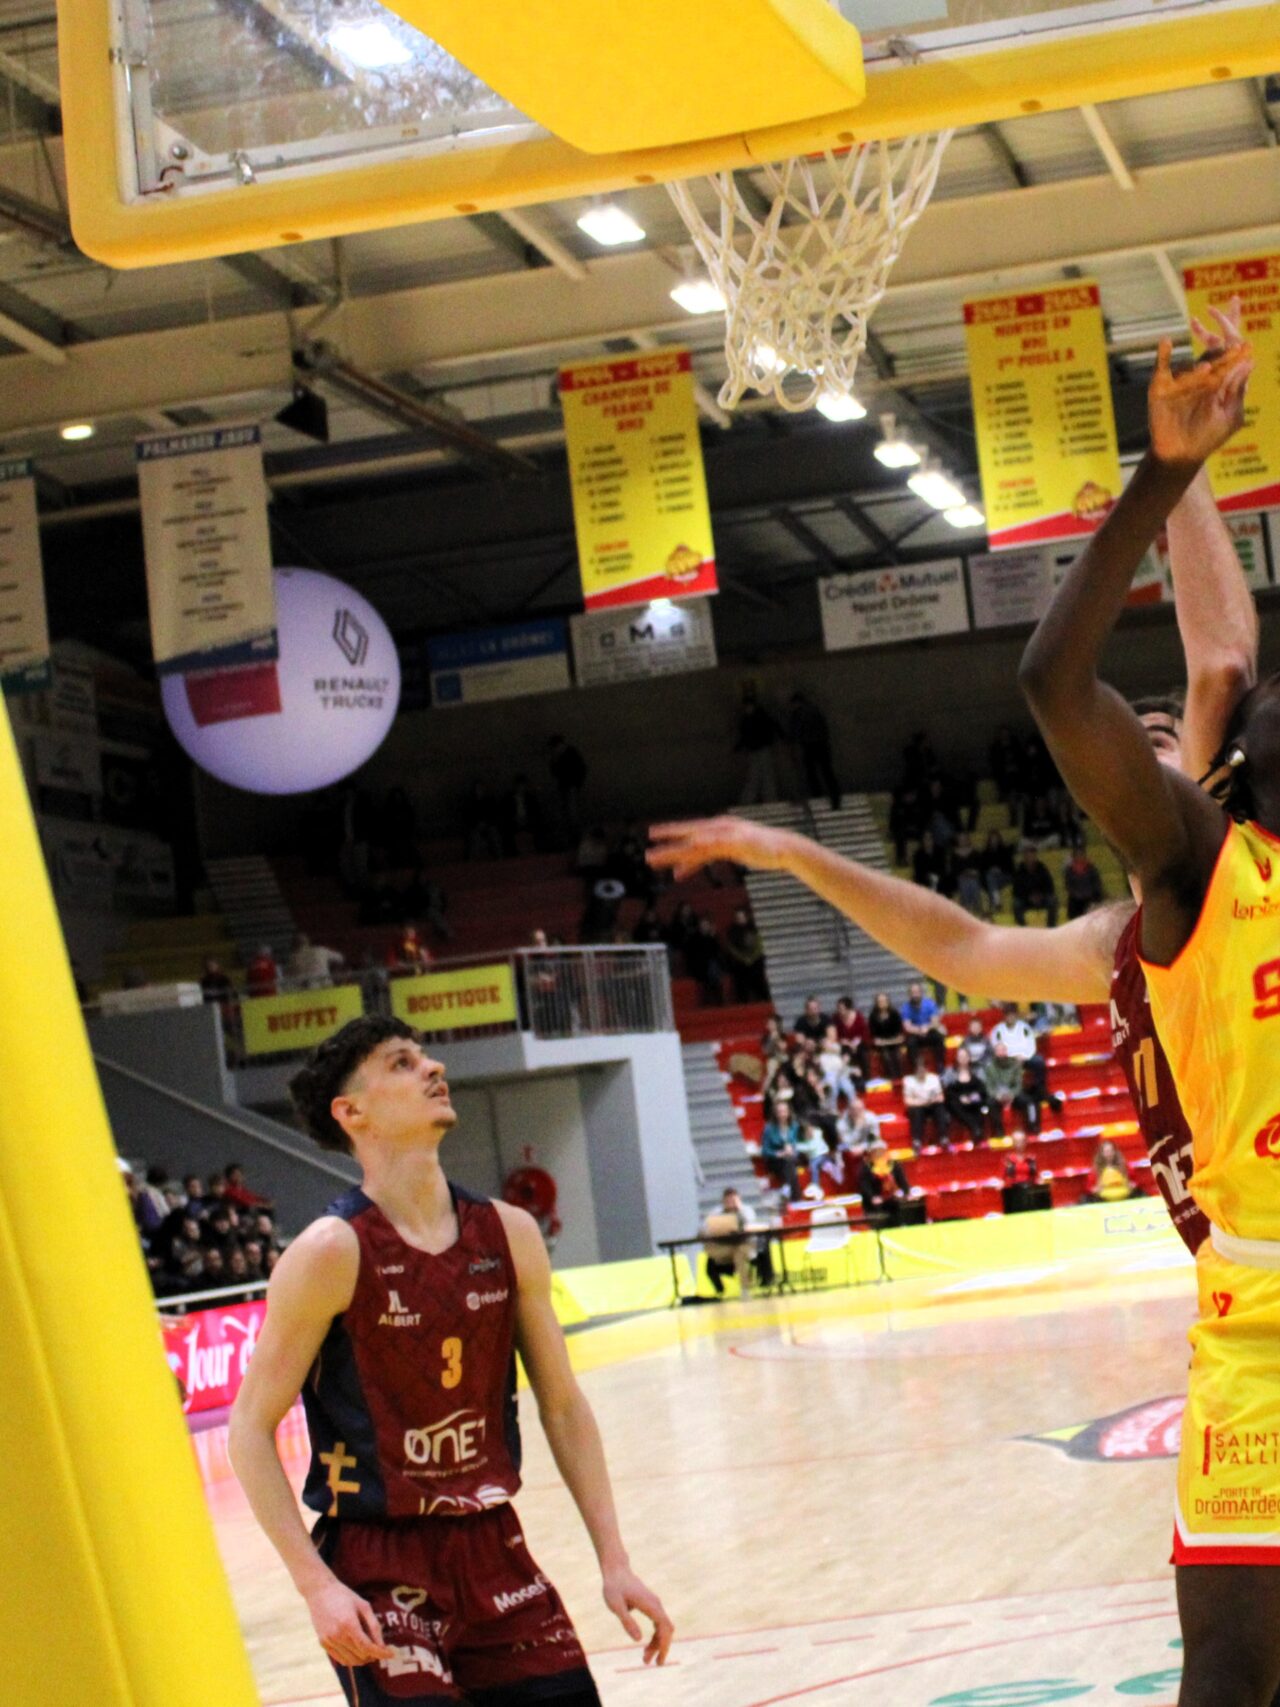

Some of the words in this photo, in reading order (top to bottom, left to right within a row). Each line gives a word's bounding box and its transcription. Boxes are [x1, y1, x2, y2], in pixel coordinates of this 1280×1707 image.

[313, 677, 389, 694] RENAULT
[320, 694, 384, 711] TRUCKS
[405, 984, 502, 1016] BOUTIQUE
[267, 1006, 338, 1034] BUFFET
[378, 1312, 421, 1328] ALBERT
[441, 1337, 463, 1389] 3
[1215, 1432, 1280, 1448] SAINT
[1219, 1486, 1249, 1498] PORTE
